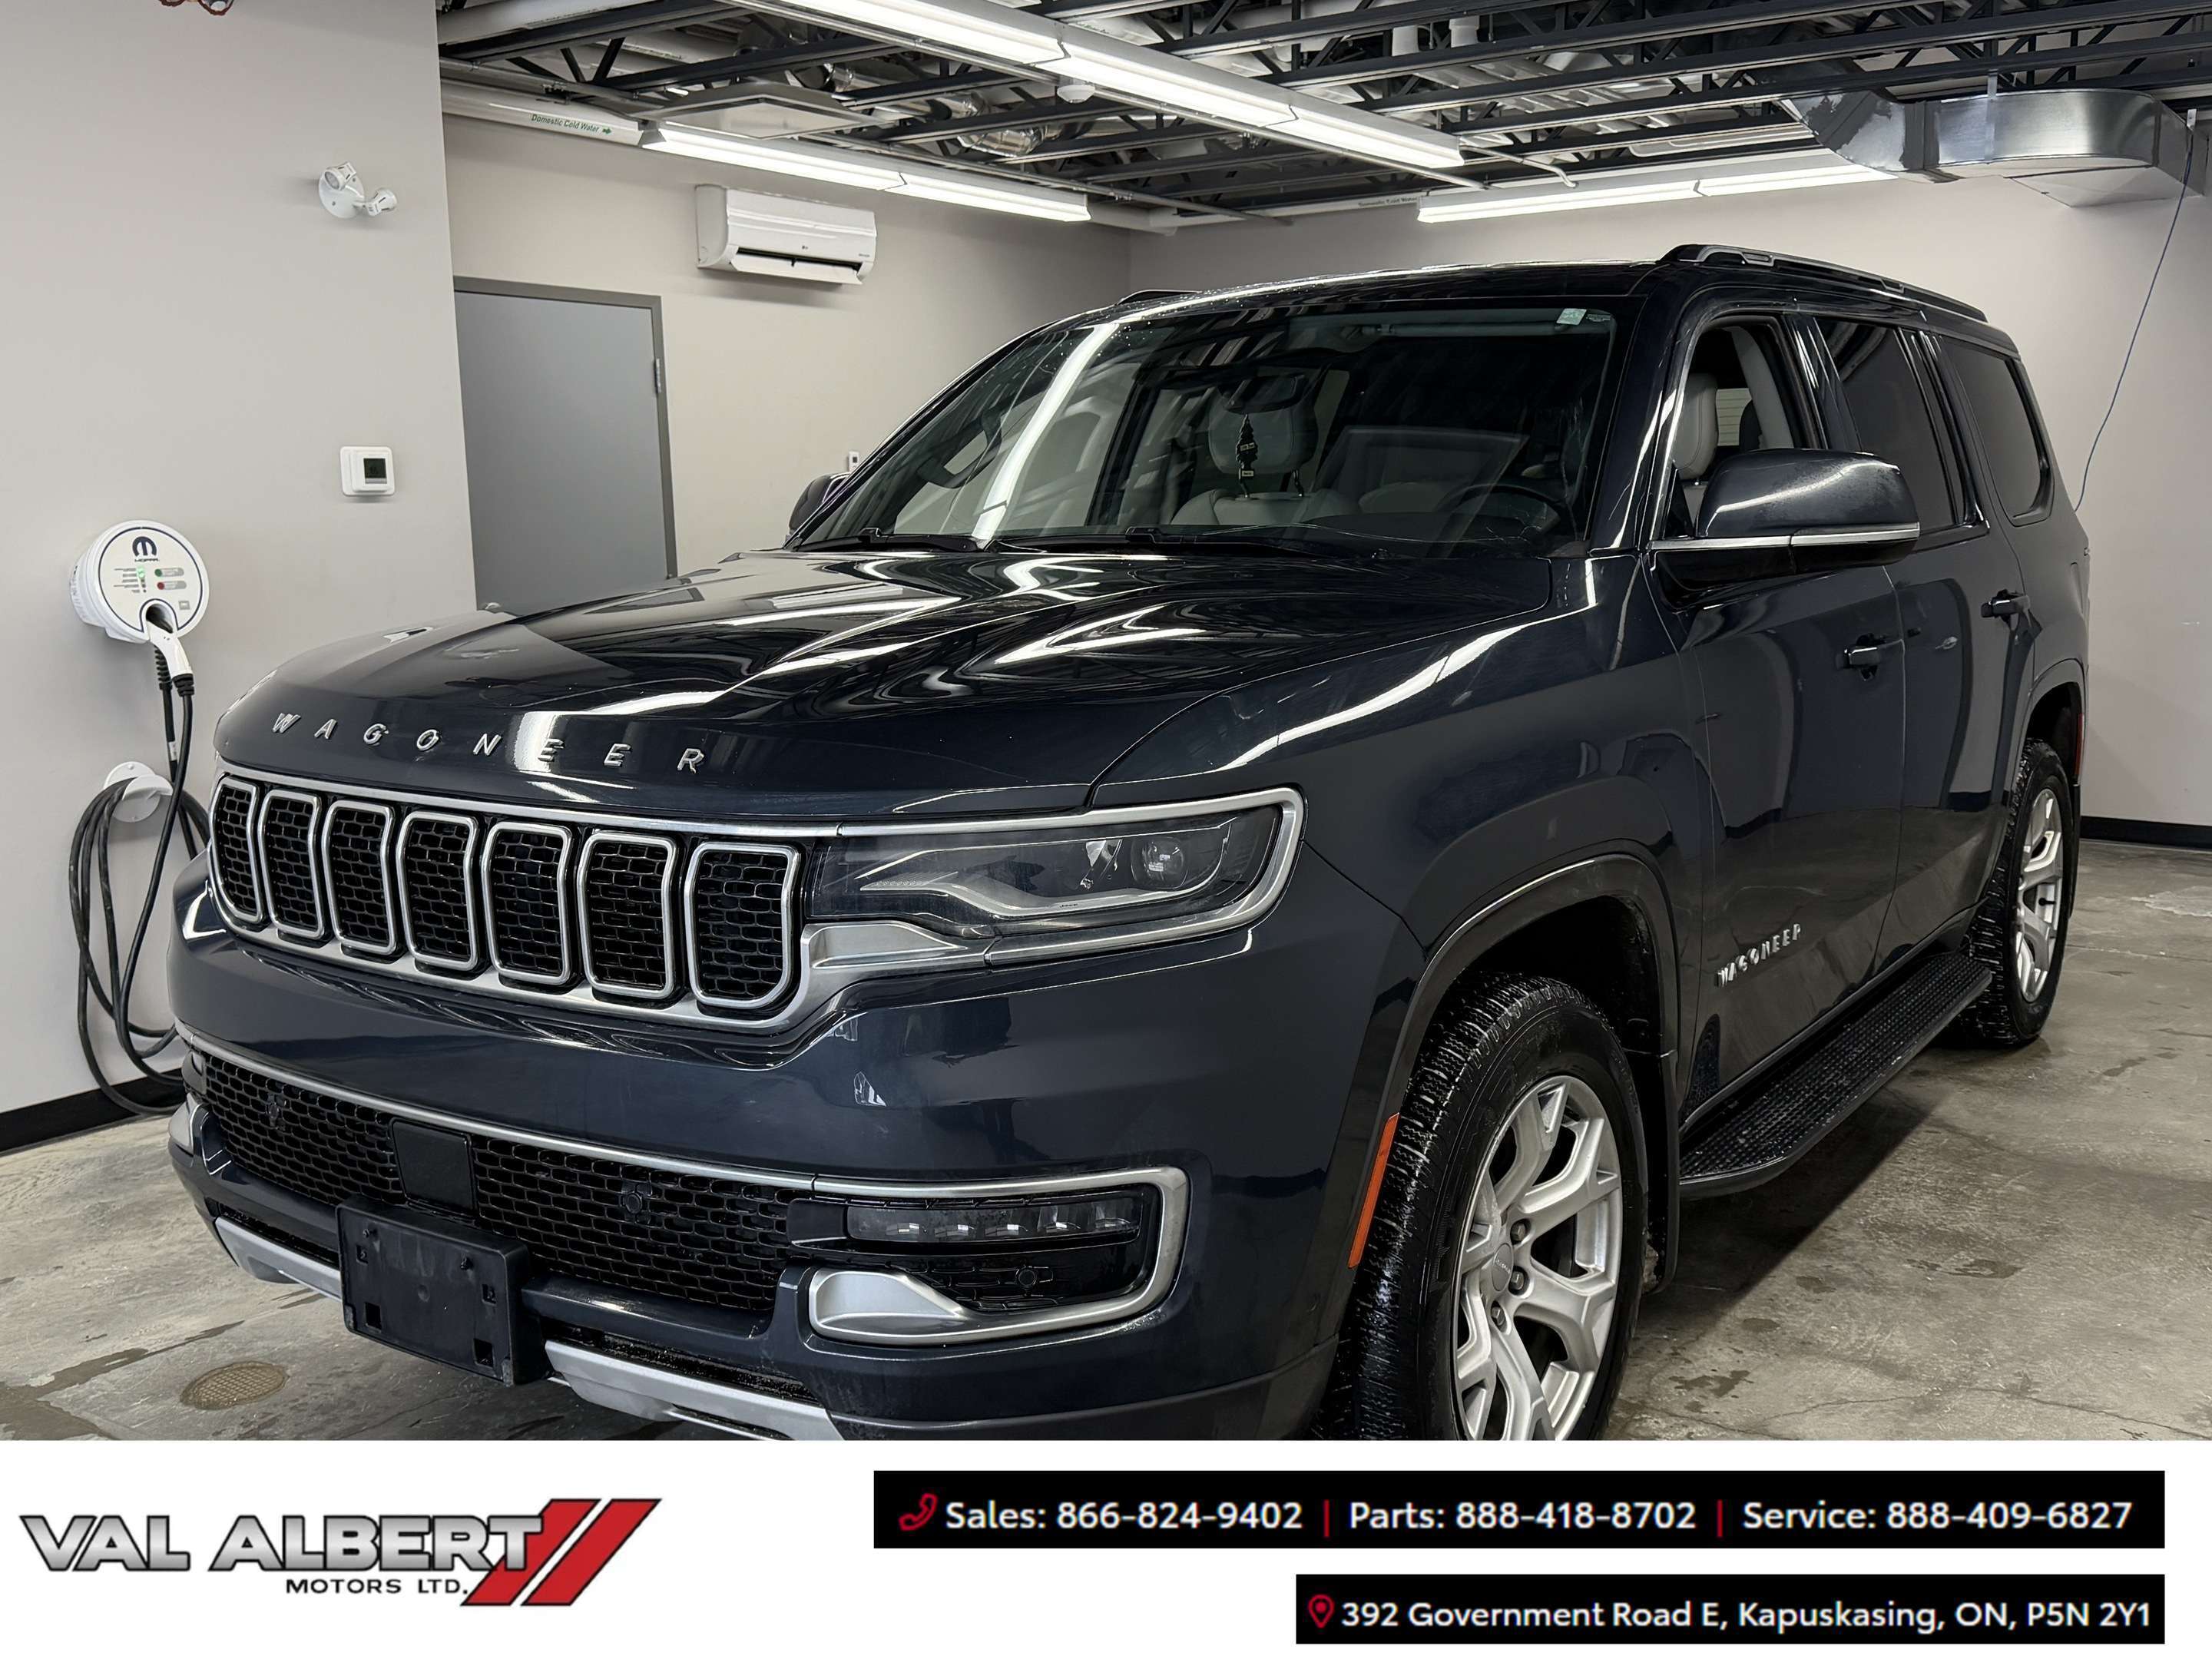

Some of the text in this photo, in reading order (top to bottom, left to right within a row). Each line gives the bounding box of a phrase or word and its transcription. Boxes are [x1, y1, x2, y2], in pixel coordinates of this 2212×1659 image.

[531, 114, 599, 133] Domestic Cold Water
[271, 712, 704, 773] WAGONEER
